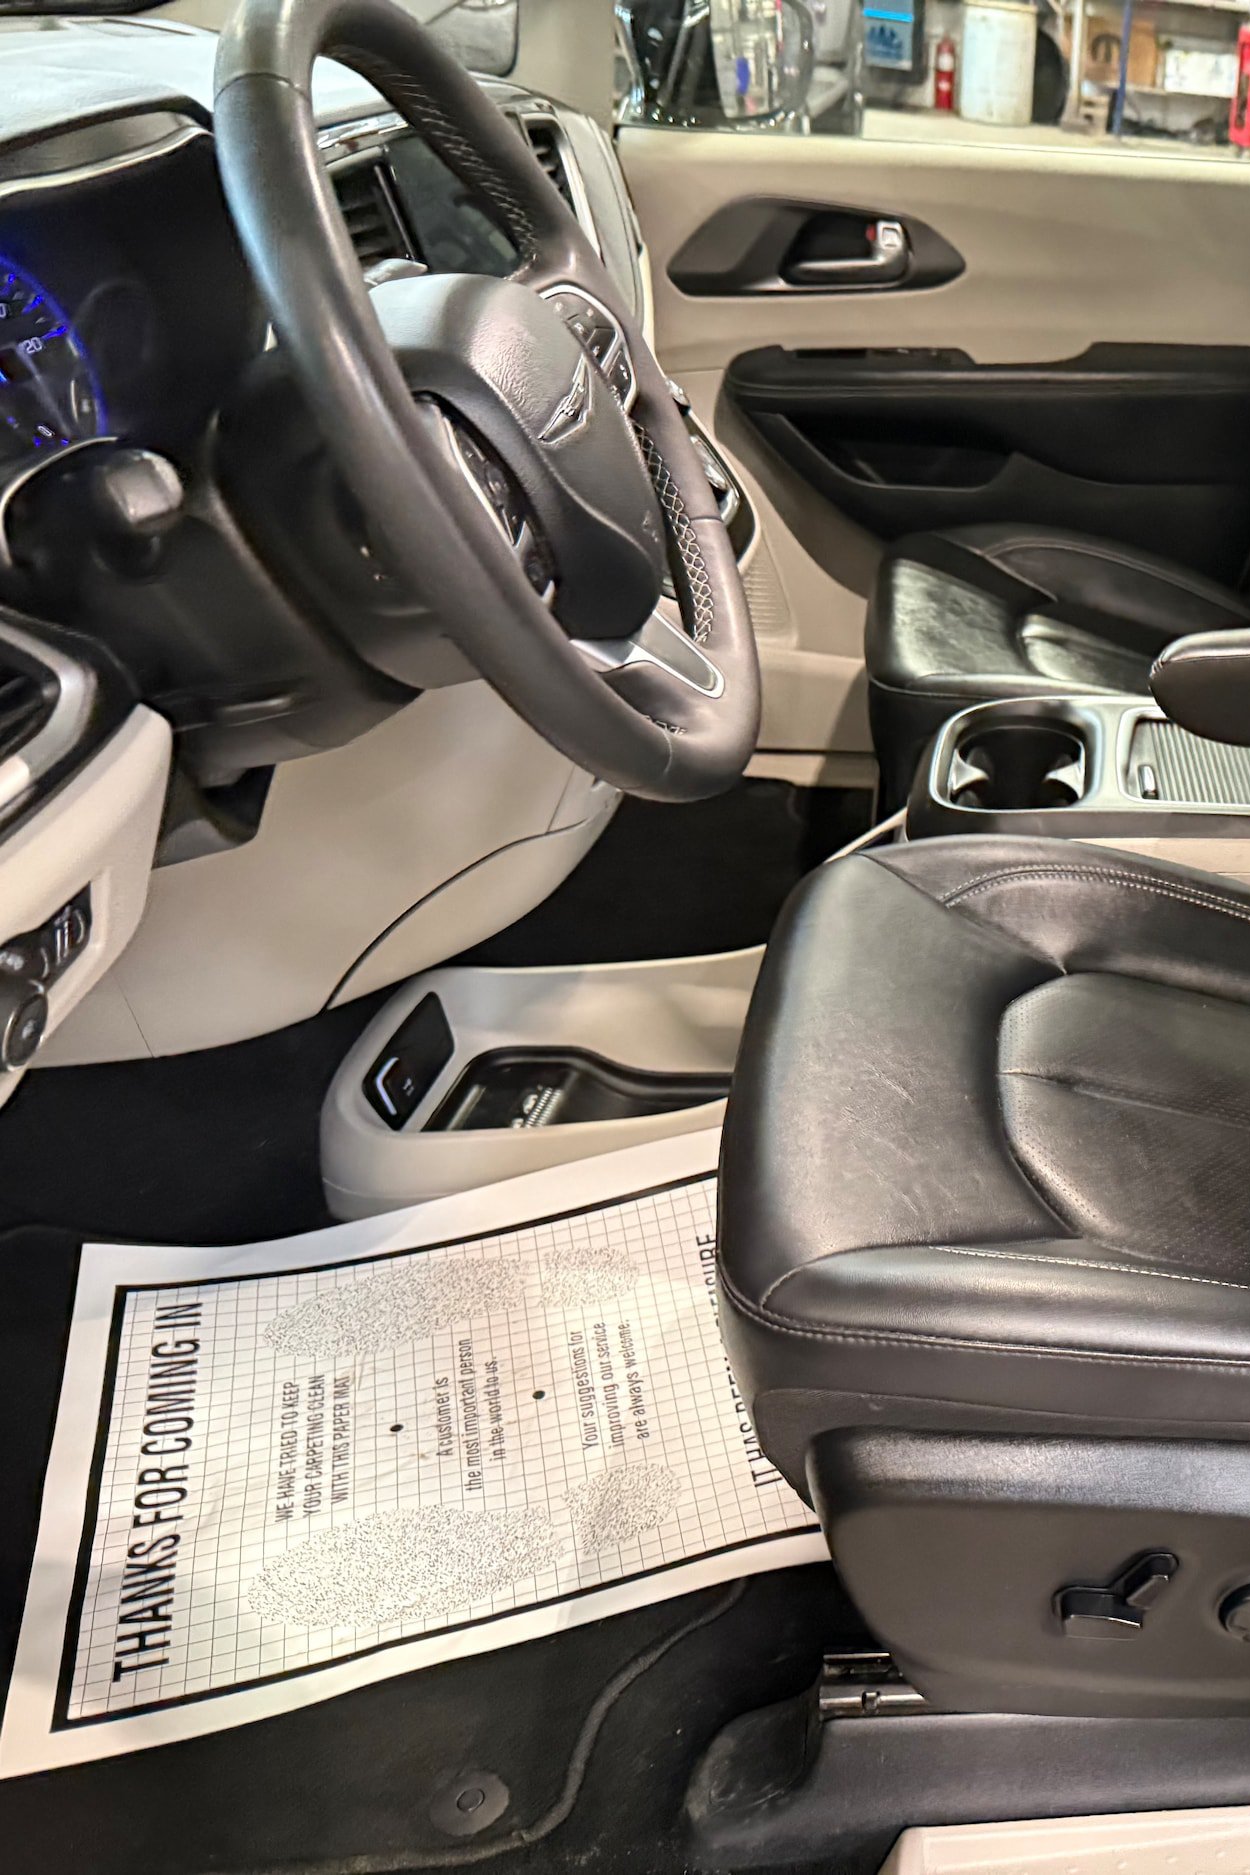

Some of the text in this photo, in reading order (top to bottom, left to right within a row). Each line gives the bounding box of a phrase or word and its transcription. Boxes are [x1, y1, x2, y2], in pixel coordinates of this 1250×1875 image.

[331, 1376, 351, 1505] WITH THIS PAPER MAT
[432, 1376, 453, 1457] A customer is
[458, 1338, 482, 1491] the most important person
[484, 1356, 506, 1462] in the world to us.
[568, 1331, 599, 1450] Your suggestions for
[592, 1322, 626, 1449] improving our service
[618, 1319, 650, 1440] are always welcome.
[112, 1302, 203, 1683] THANKS FOR COMING IN
[275, 1381, 300, 1523] WE HAVE TRIED TO KEEP
[303, 1374, 325, 1518] YOUR CARPETING CLEAN
[752, 1468, 783, 1488] IT
